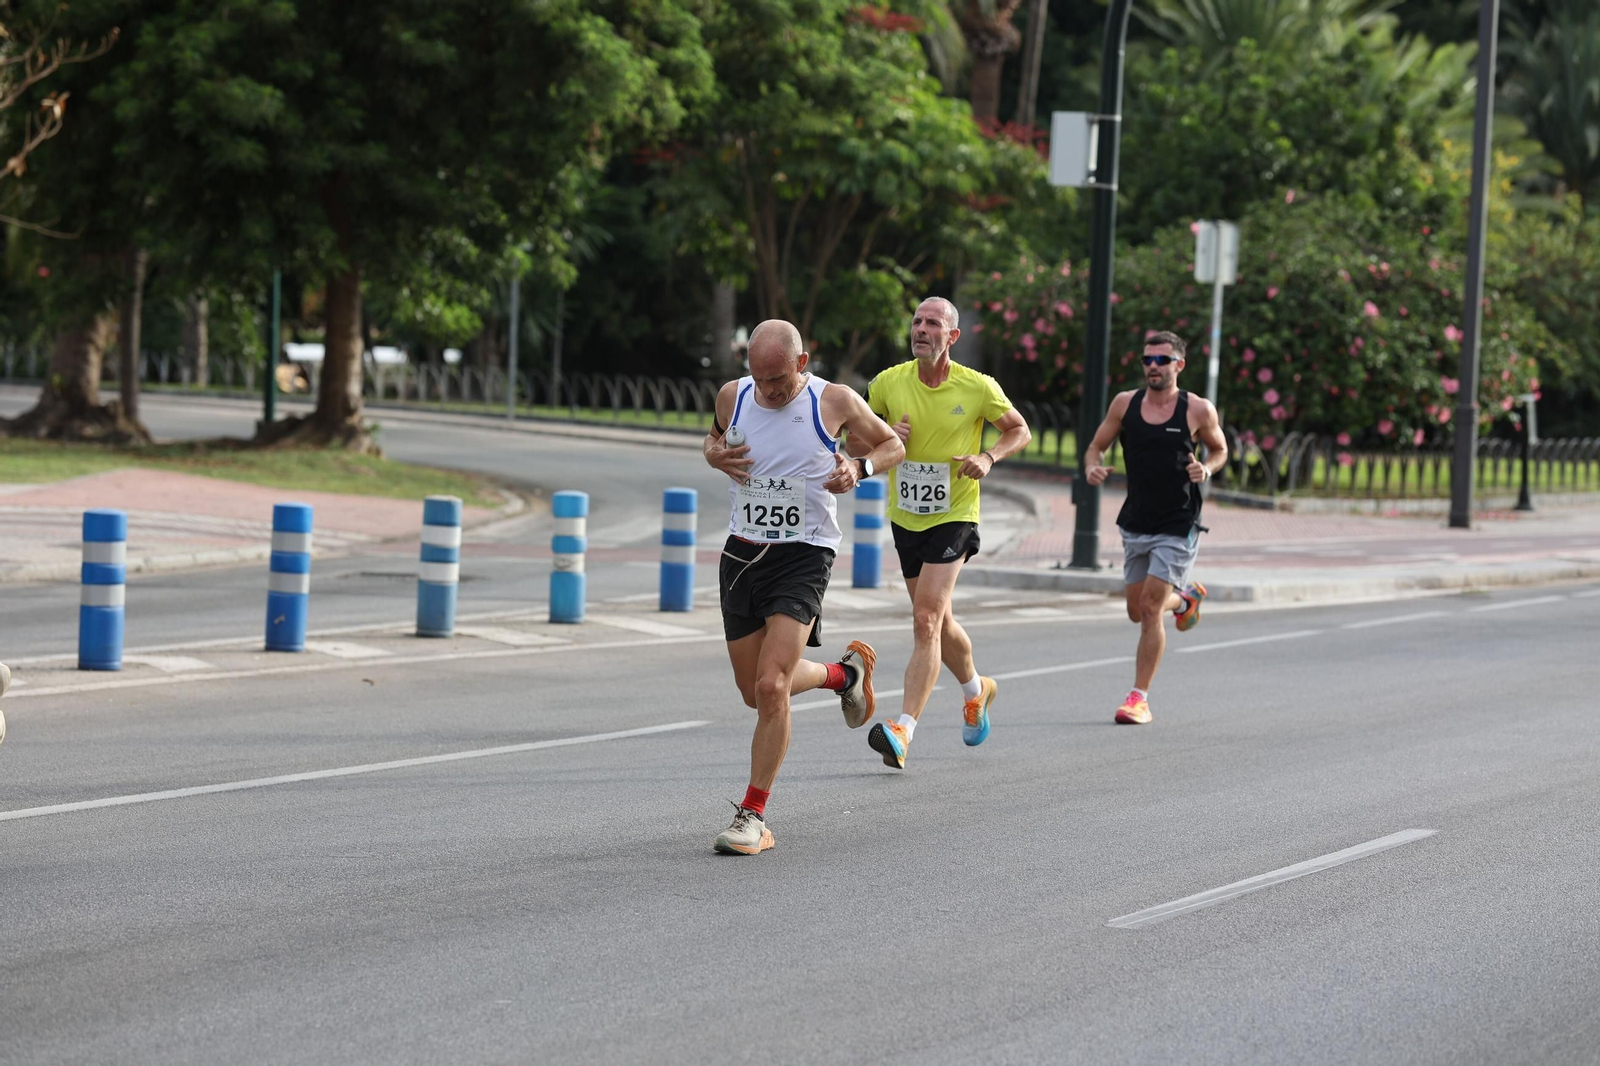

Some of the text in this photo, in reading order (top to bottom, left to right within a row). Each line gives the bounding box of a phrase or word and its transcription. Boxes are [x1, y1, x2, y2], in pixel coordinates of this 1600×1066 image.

[744, 478, 763, 489] 45
[900, 481, 946, 501] 8126
[743, 503, 800, 527] 1256
